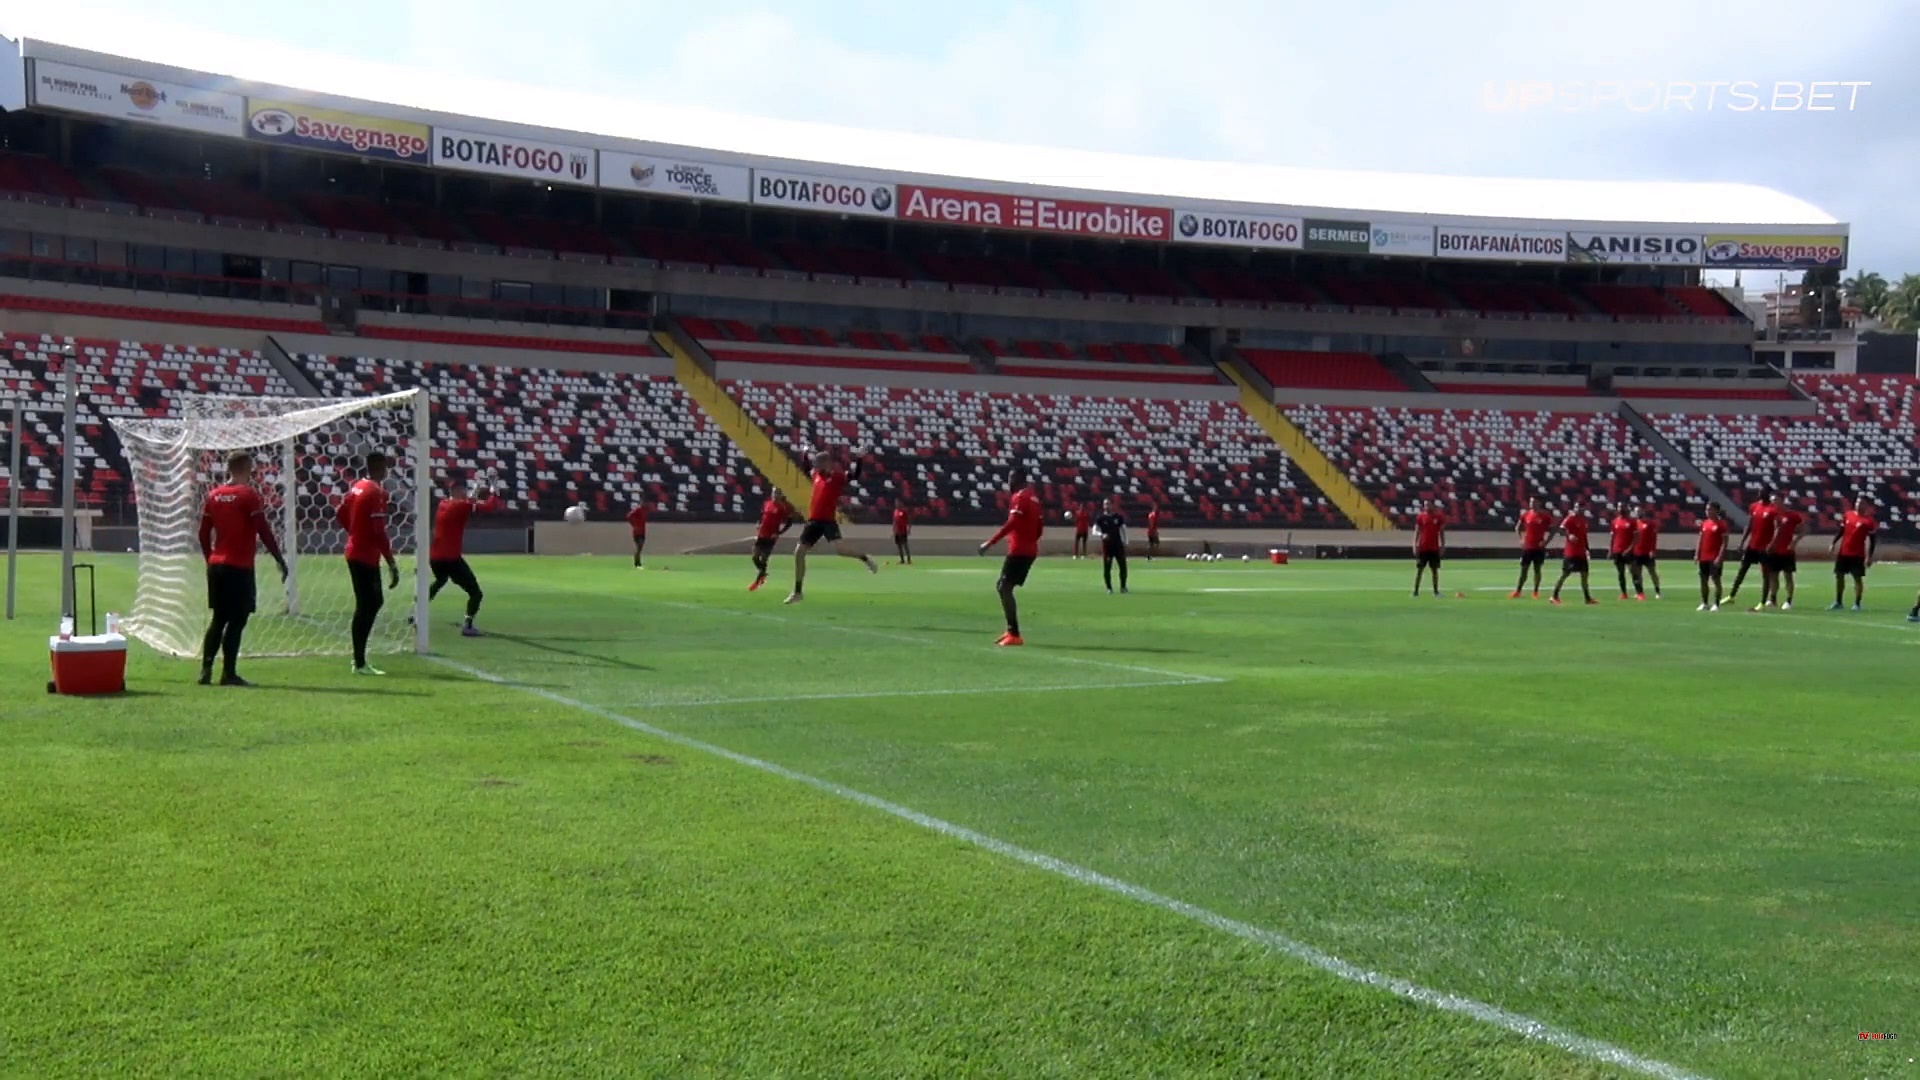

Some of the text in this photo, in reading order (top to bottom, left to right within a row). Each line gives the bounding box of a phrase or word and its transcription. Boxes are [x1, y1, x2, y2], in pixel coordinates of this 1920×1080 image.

[295, 115, 427, 157] Savegnago
[441, 136, 564, 173] BOTAFOGO
[665, 169, 712, 187] TORCE
[760, 177, 866, 207] BOTAFOGO
[905, 189, 1164, 236] Arena Eurobike
[1203, 218, 1298, 242] BOTAFOGO
[1308, 228, 1369, 243] SERMED
[1440, 233, 1563, 254] BOTAFANÁTICOS
[1739, 242, 1842, 264] Savegnago
